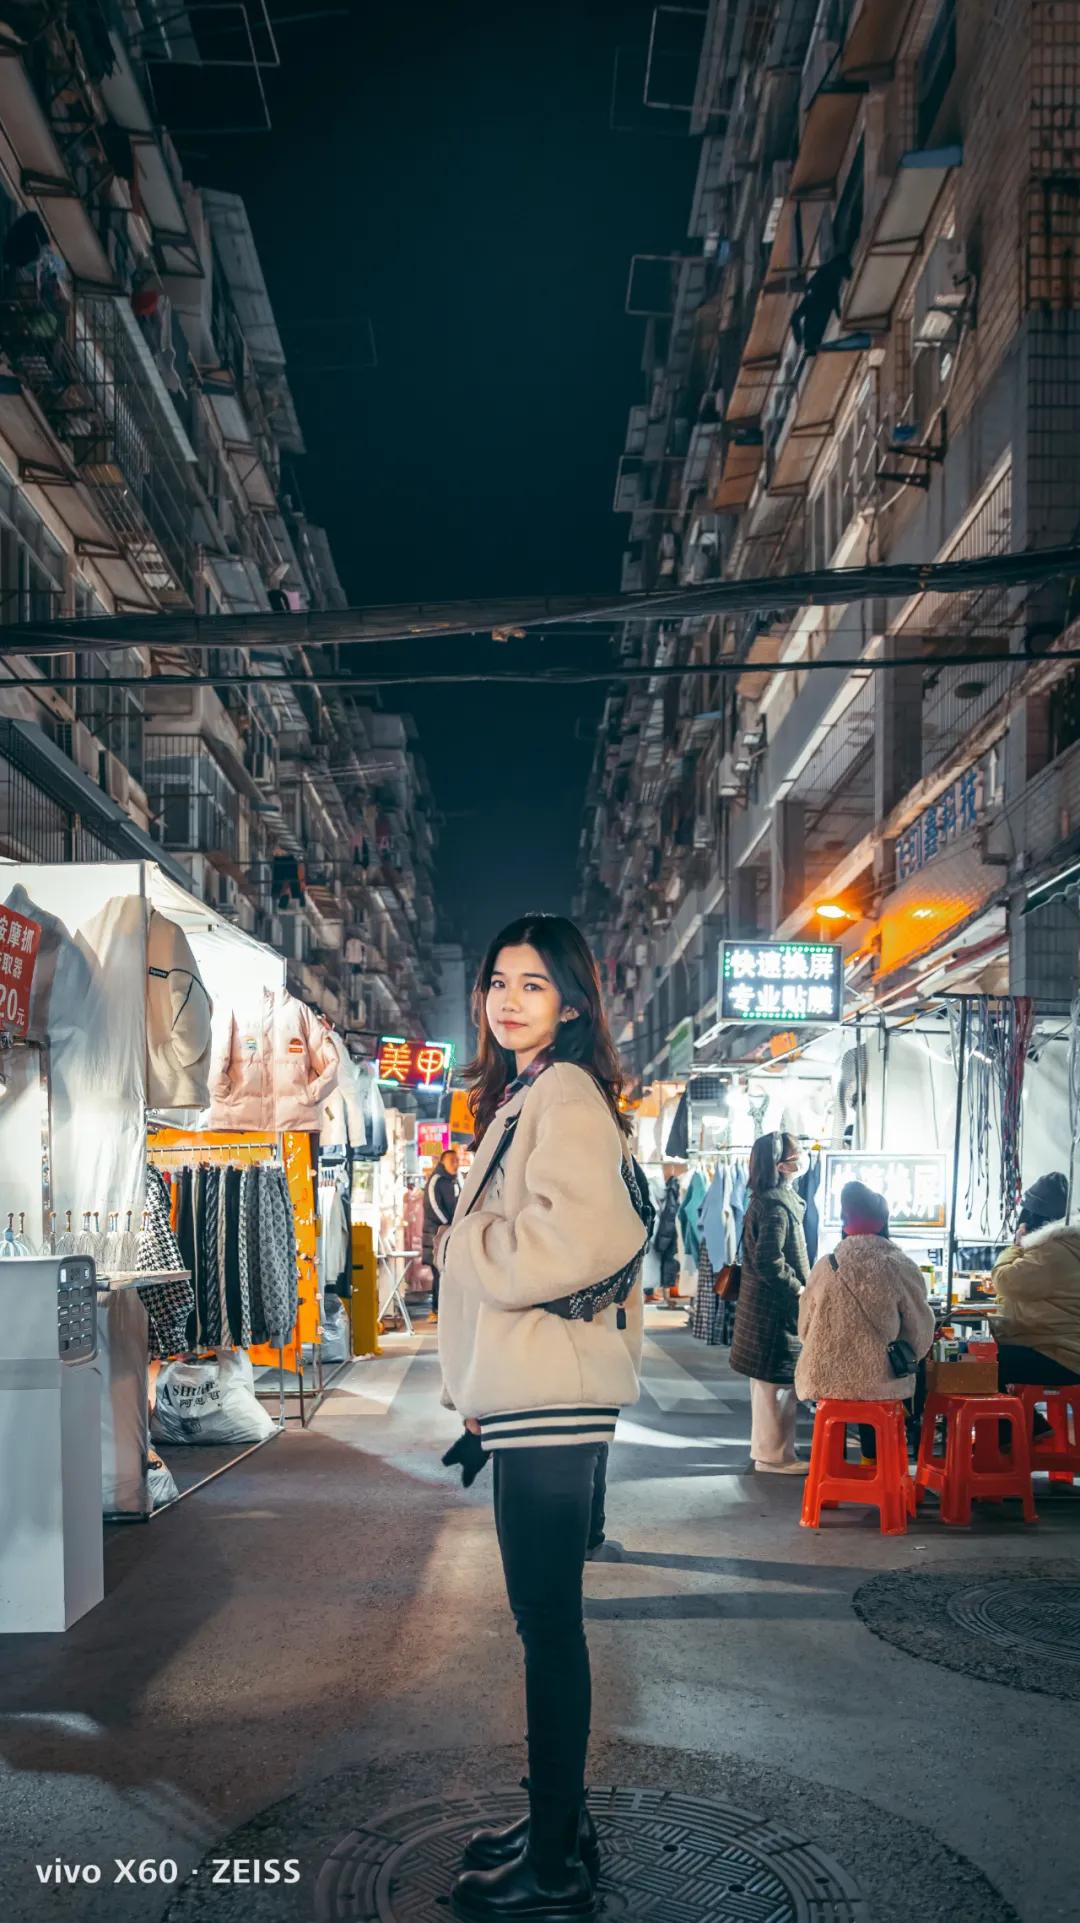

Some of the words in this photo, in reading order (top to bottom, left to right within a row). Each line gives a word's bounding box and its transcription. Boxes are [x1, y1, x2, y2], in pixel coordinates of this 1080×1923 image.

[730, 949, 834, 980] 快速换屏
[380, 1043, 444, 1086] 美甲
